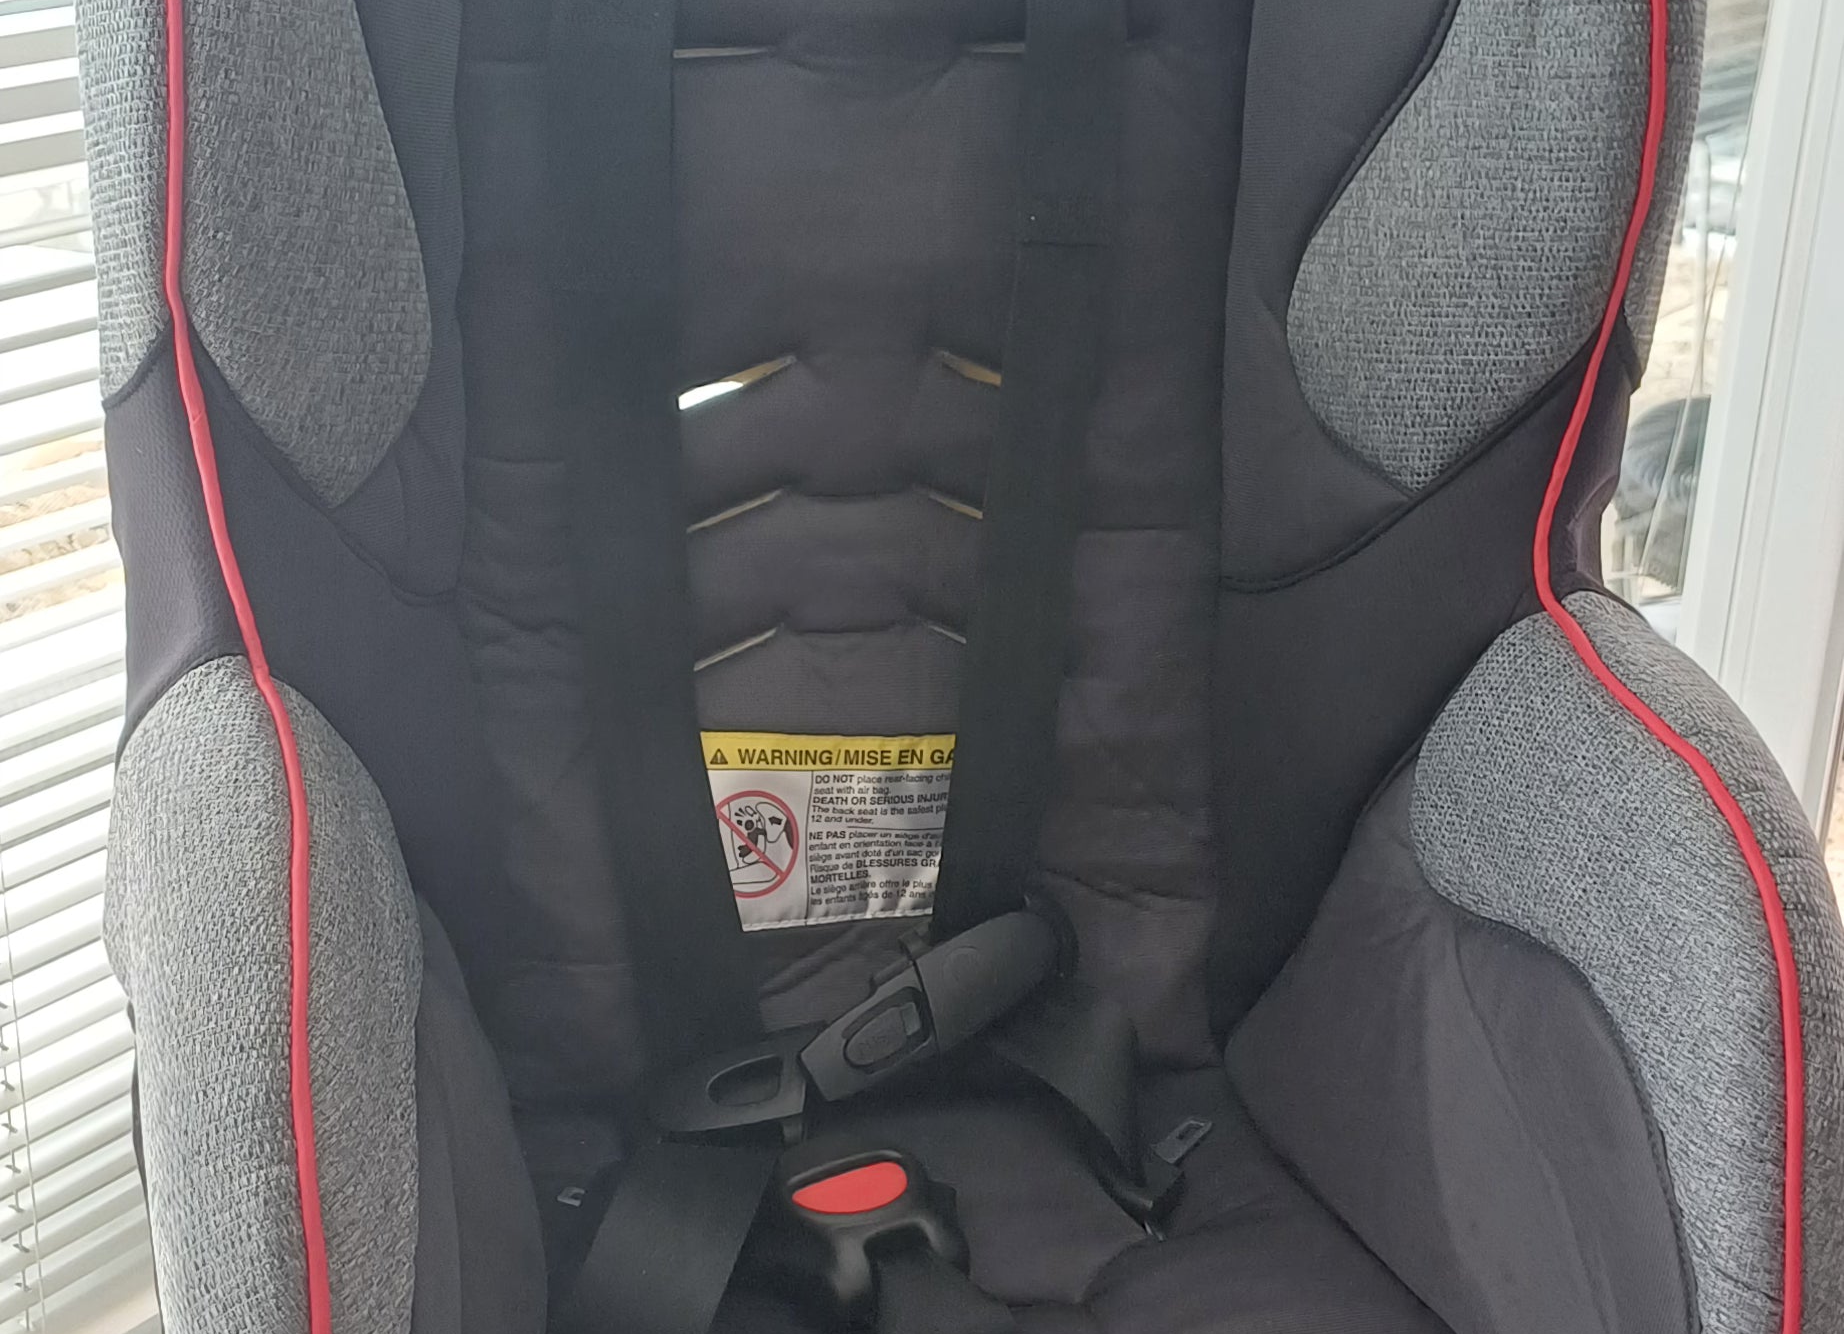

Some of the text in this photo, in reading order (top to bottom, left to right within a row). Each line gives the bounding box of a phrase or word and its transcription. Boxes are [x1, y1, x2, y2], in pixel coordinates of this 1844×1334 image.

[897, 748, 923, 764] EN
[815, 774, 830, 784] DO
[832, 774, 854, 784] NOT
[857, 774, 880, 786] place
[884, 773, 932, 785] rear-facing
[814, 785, 891, 796] seat with air bag.
[812, 796, 848, 805] DEATH
[851, 796, 866, 806] OR
[869, 794, 914, 806] SERIOUS
[812, 805, 830, 814] The
[832, 806, 854, 815] back
[857, 807, 877, 815] seat
[880, 807, 887, 815] is
[890, 806, 904, 815] the
[907, 805, 933, 815] safest
[811, 814, 874, 824] 12 and under.
[809, 831, 823, 840] NE
[826, 830, 846, 840] PAS
[848, 830, 878, 840] placer
[880, 831, 892, 839] un
[809, 841, 837, 851] enfant
[839, 842, 851, 850] en
[853, 839, 901, 849] orientation
[904, 839, 924, 848] face
[835, 850, 859, 860] avant
[861, 848, 882, 858] doté
[884, 848, 904, 857] d'un
[906, 849, 922, 857] sac
[810, 863, 839, 873] Risque
[842, 861, 854, 870] de
[856, 858, 918, 869] BLESSURES
[810, 869, 871, 884] MORTELLES.
[810, 885, 821, 895] Le
[879, 879, 899, 888] offre
[902, 878, 910, 887] le
[912, 880, 933, 889] plus
[810, 896, 822, 905] les
[825, 893, 856, 905] enfants
[881, 891, 893, 900] de
[896, 889, 907, 899] 12
[909, 891, 926, 899] ans
